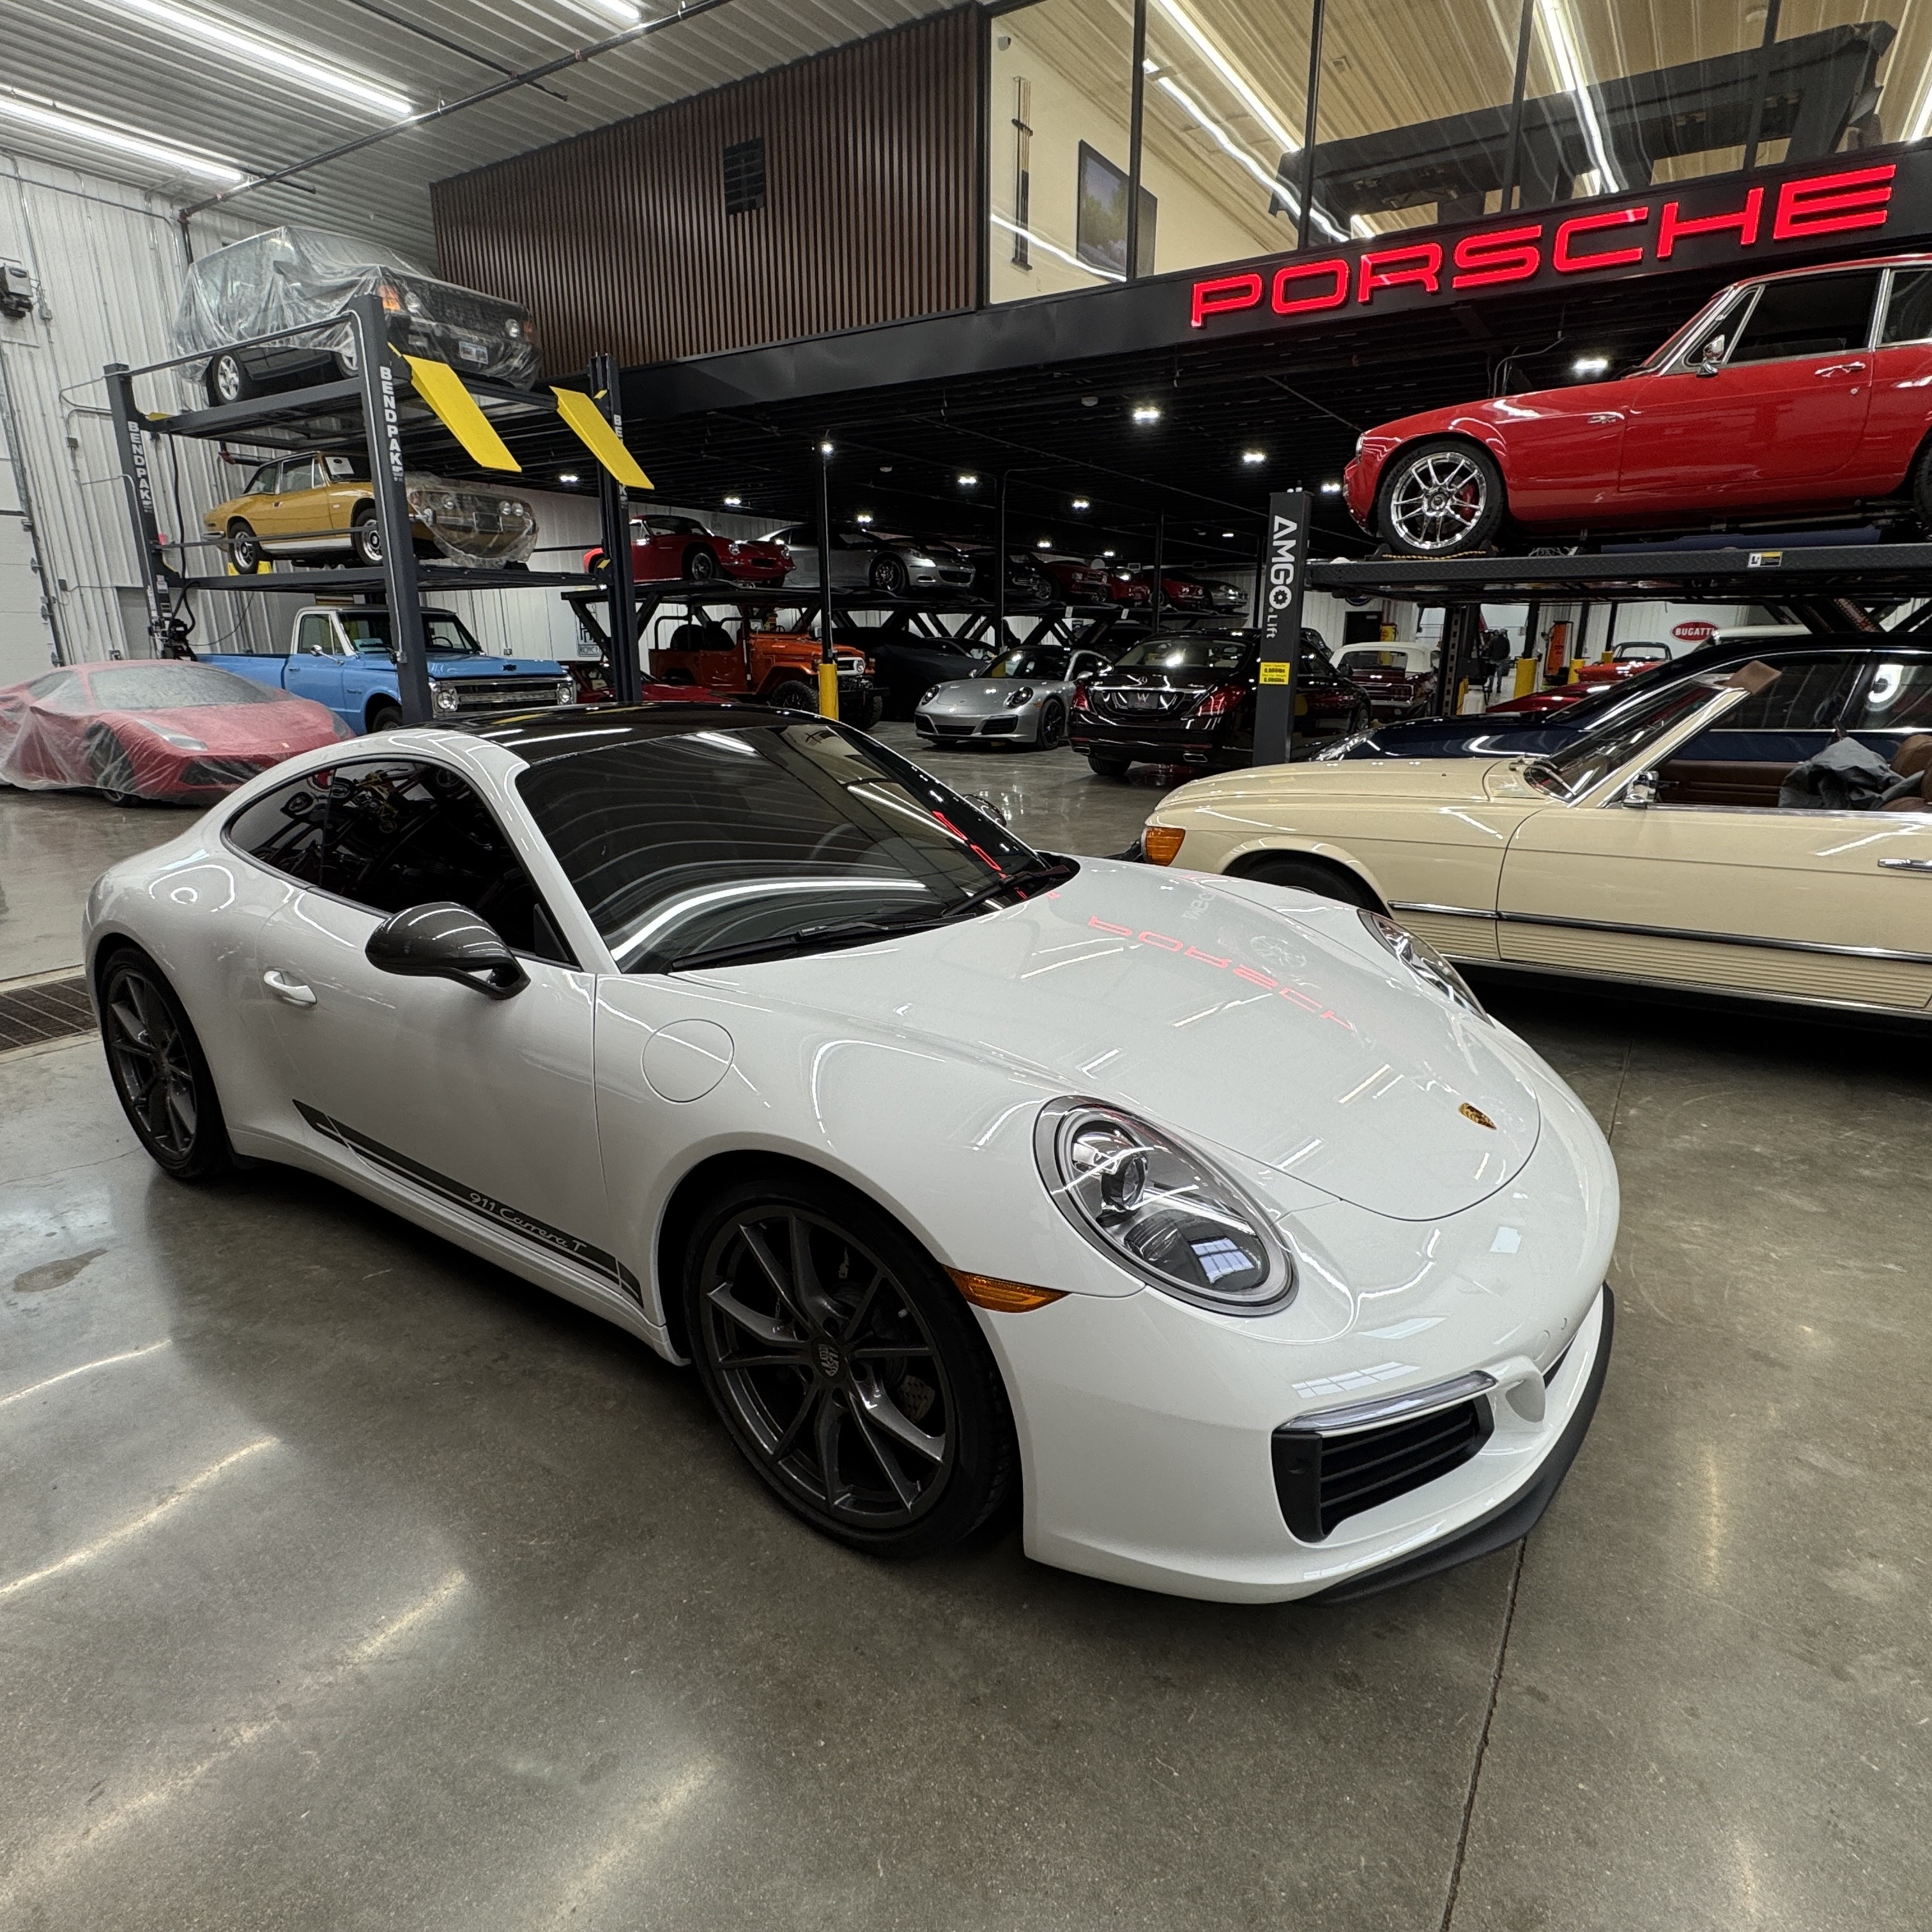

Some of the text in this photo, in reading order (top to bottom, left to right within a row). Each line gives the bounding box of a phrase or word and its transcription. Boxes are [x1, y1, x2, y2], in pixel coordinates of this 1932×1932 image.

[1191, 164, 1896, 327] PORSCHE
[128, 421, 151, 500] BENDPAK
[379, 366, 402, 465] BENDPAK
[1269, 515, 1298, 609] AMGO
[470, 1193, 587, 1252] 911 Carrera T
